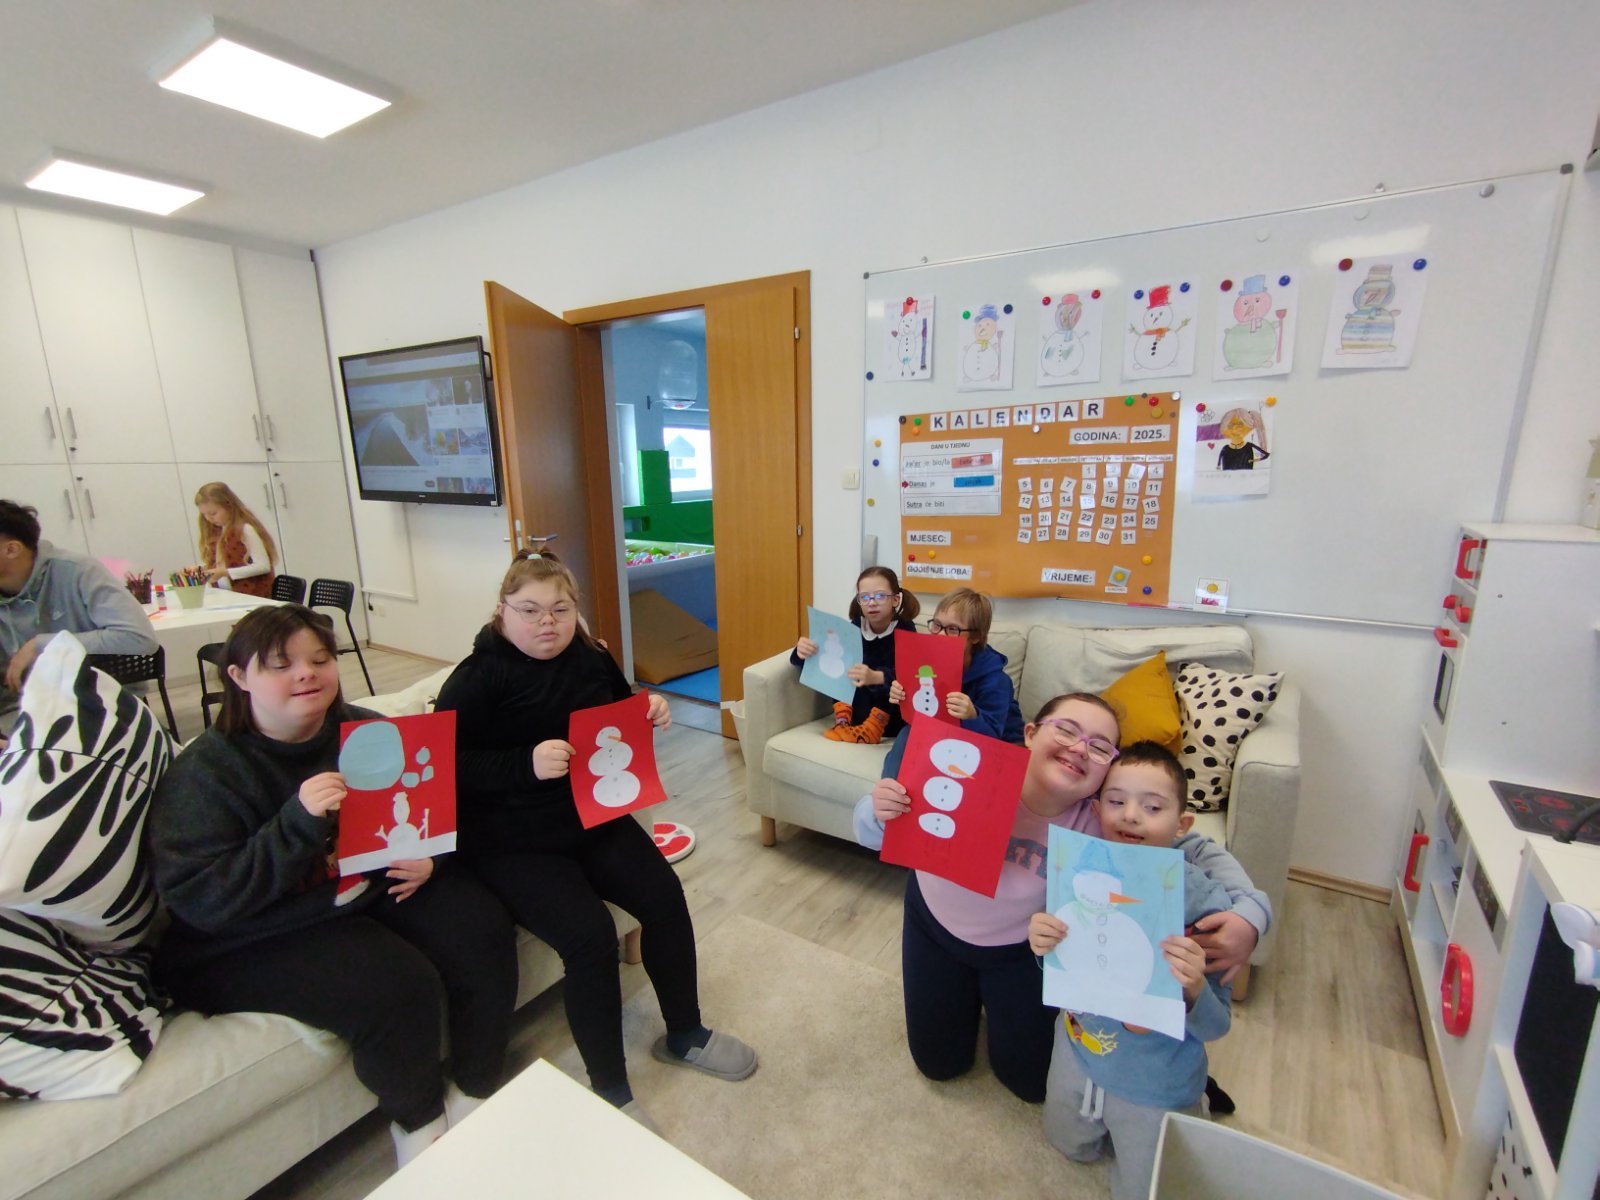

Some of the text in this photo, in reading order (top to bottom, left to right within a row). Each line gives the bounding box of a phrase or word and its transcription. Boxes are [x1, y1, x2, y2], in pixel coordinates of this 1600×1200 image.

[934, 402, 1099, 428] KALENDAR
[1074, 429, 1166, 441] GODINA: 2025.
[1127, 481, 1137, 489] 10
[906, 501, 922, 509] Sutra
[1040, 496, 1049, 504] 13
[1104, 496, 1115, 504] 16
[1145, 500, 1157, 508] 18
[1060, 512, 1069, 520] 21
[1081, 514, 1092, 522] 22
[910, 534, 946, 543] MJESEC:
[1079, 530, 1090, 538] 29
[1098, 532, 1109, 540] 30
[1044, 572, 1093, 583] VRIJEME:
